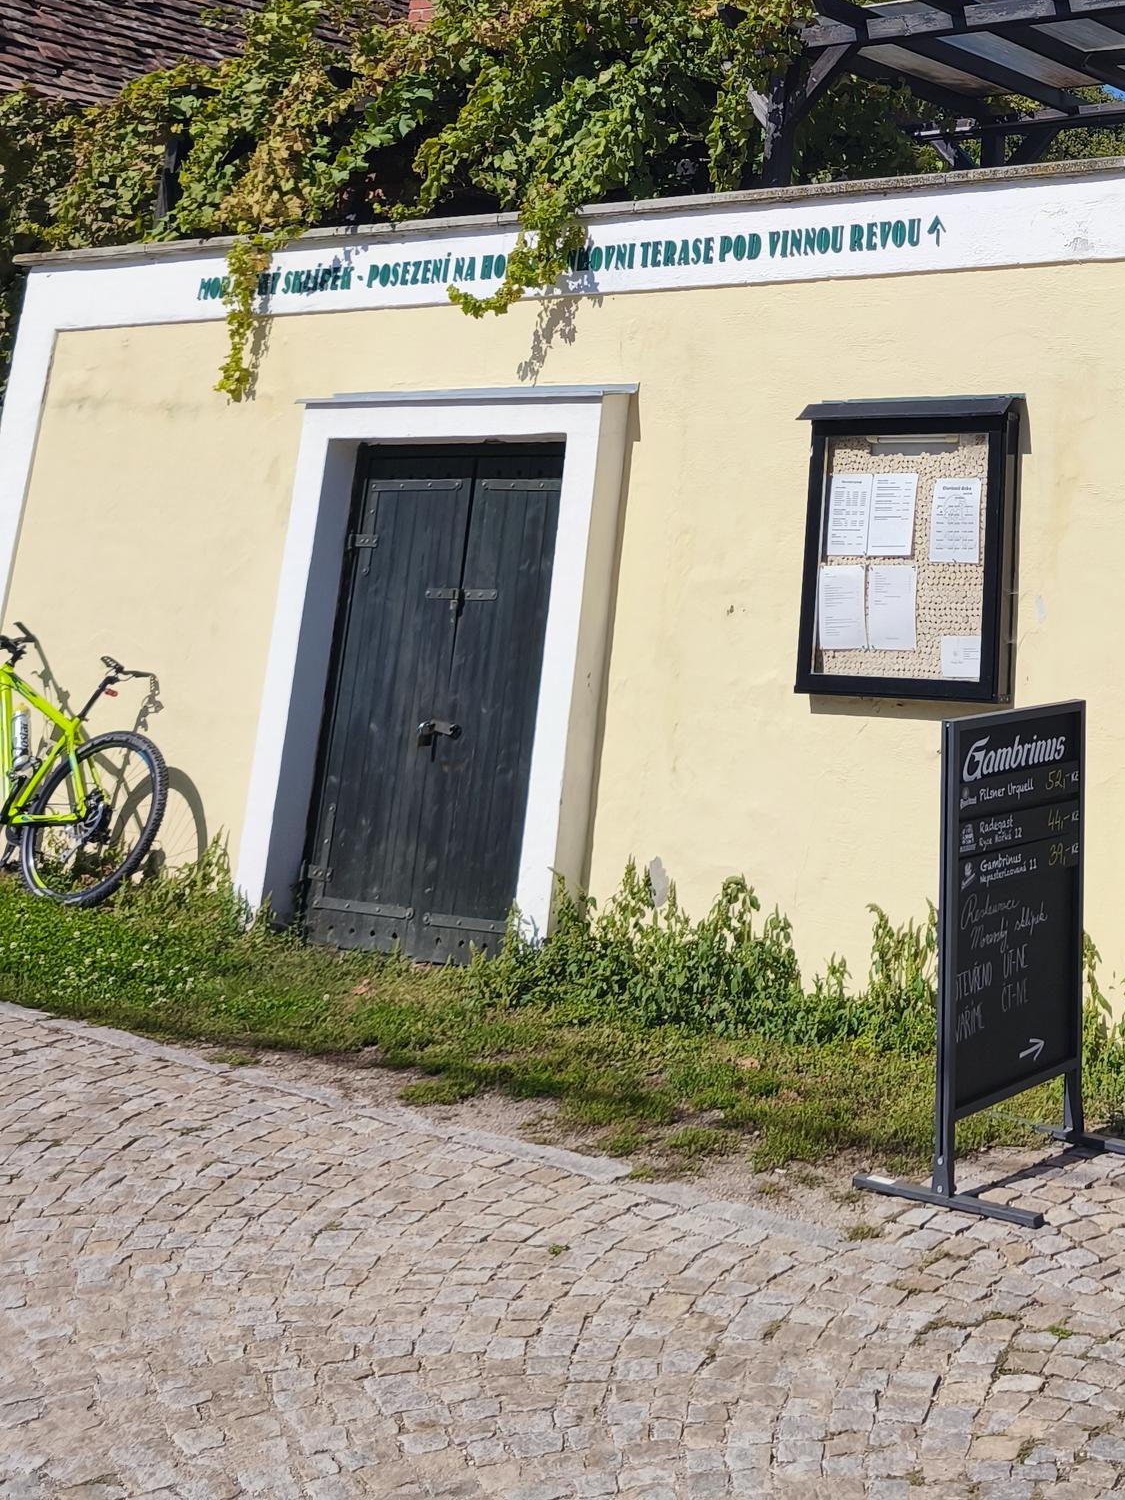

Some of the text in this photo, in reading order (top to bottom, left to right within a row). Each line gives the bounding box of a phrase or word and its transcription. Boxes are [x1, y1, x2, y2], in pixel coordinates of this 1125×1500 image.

[197, 267, 282, 300] MORKÝ
[282, 263, 354, 295] SKLÍPEK
[366, 252, 452, 288] POSEZENÍ
[453, 256, 476, 282] NA
[640, 237, 714, 268] TERASE
[718, 232, 762, 262] POD
[769, 225, 844, 258] VINNOU
[849, 218, 921, 252] REVOU
[962, 734, 1066, 783] Gambrinus
[979, 787, 1006, 802] Pilsner
[1007, 778, 1034, 800] Urquell
[979, 814, 1014, 834] Radegast
[979, 853, 1022, 872] Gambrinus
